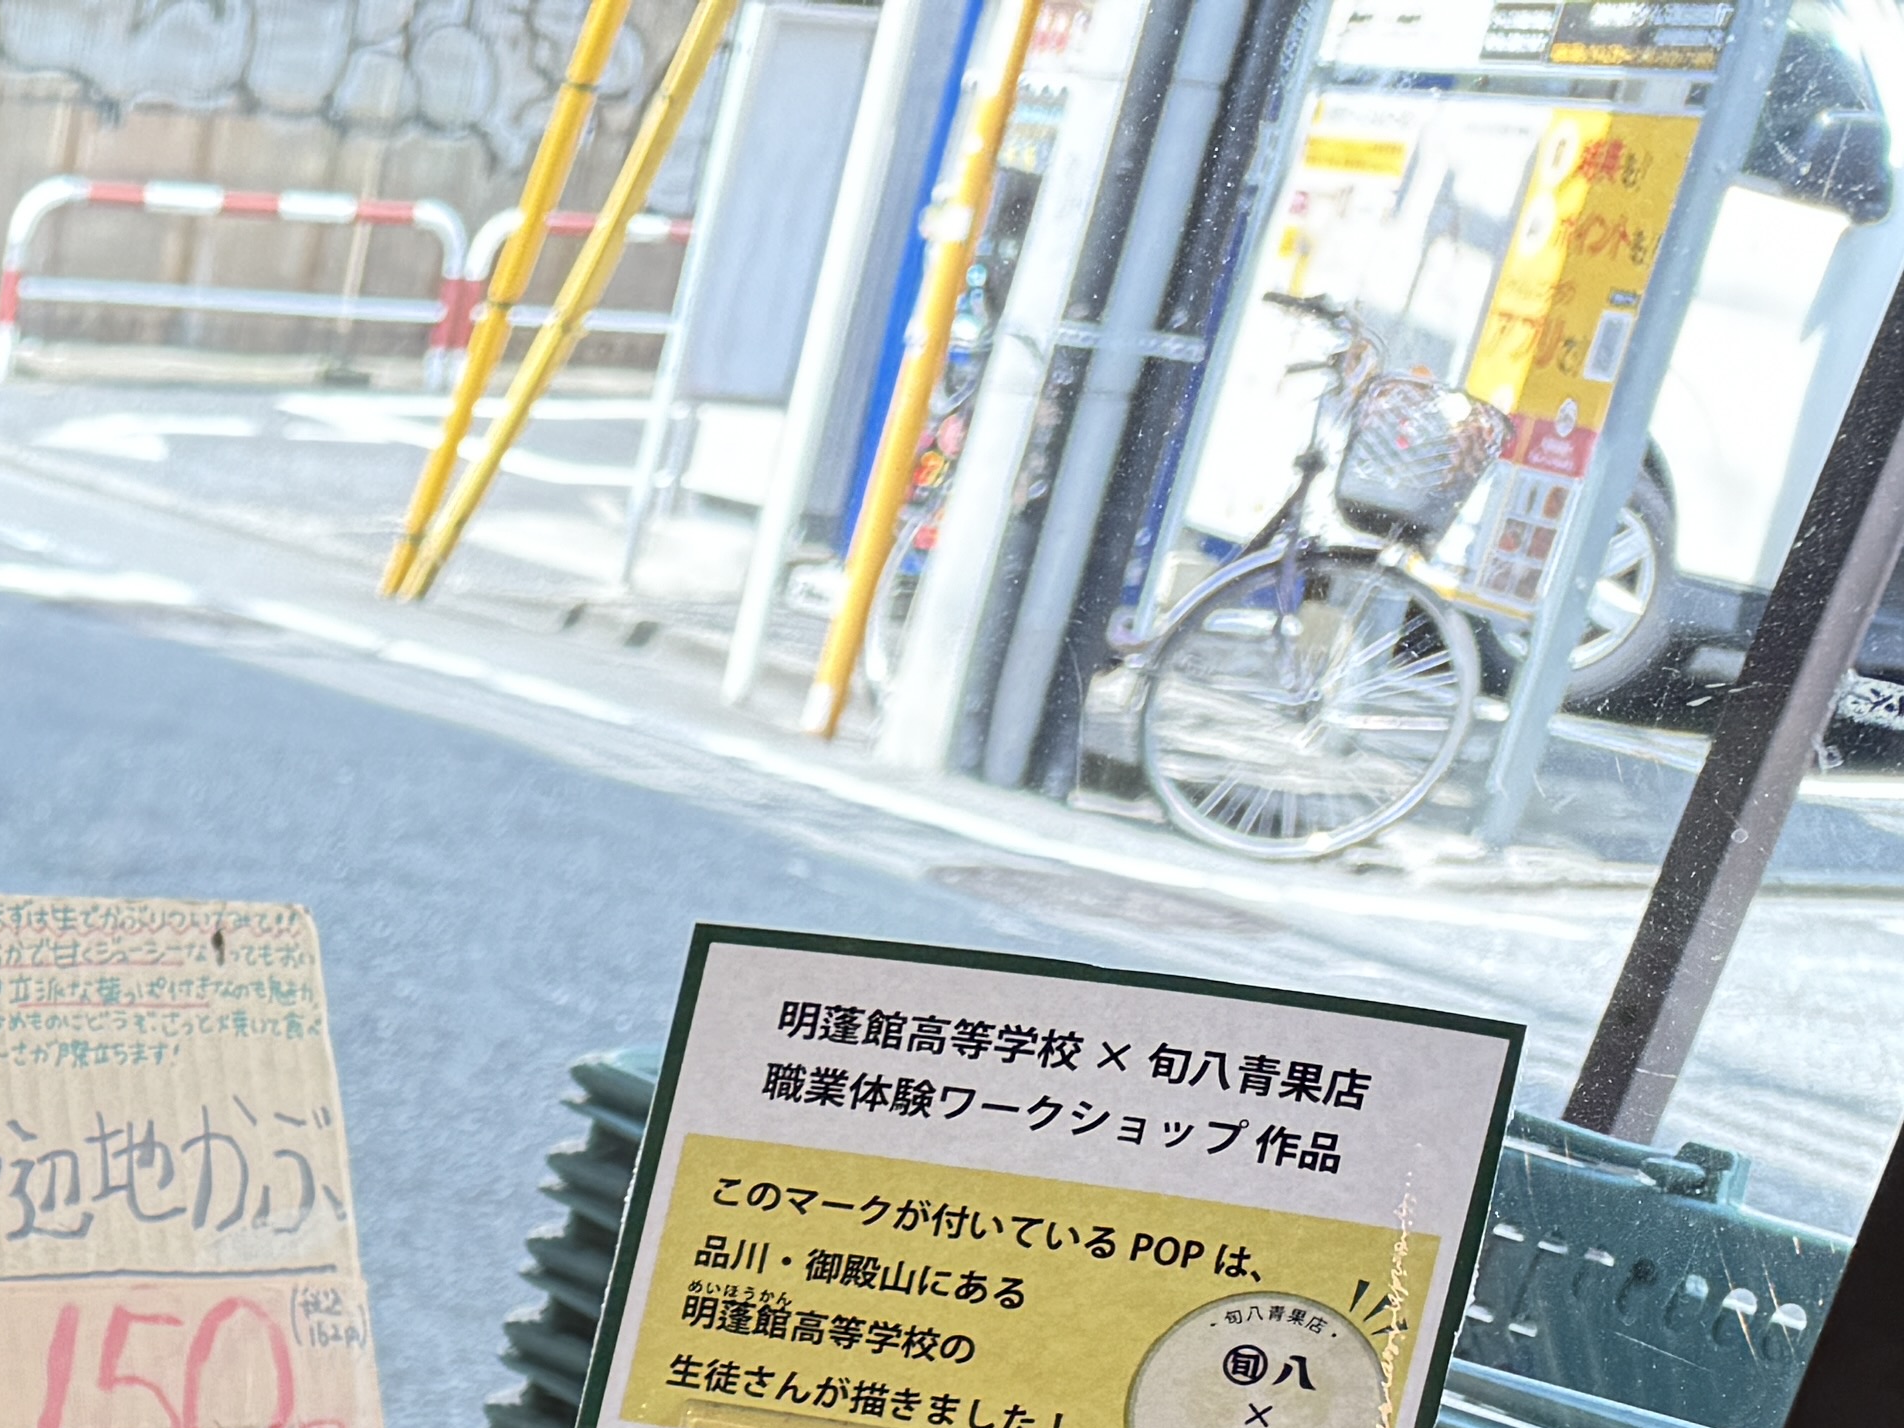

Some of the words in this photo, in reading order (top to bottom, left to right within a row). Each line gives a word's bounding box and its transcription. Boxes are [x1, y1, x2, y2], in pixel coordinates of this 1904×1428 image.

[778, 1000, 1085, 1073] 明蓬館高等学校
[1148, 1043, 1373, 1111] 旬八青果店
[686, 1280, 794, 1306] めいほうかん
[694, 1235, 1028, 1311] 品川・御殿山にある
[681, 1293, 977, 1366] 明蓬館高等学校の
